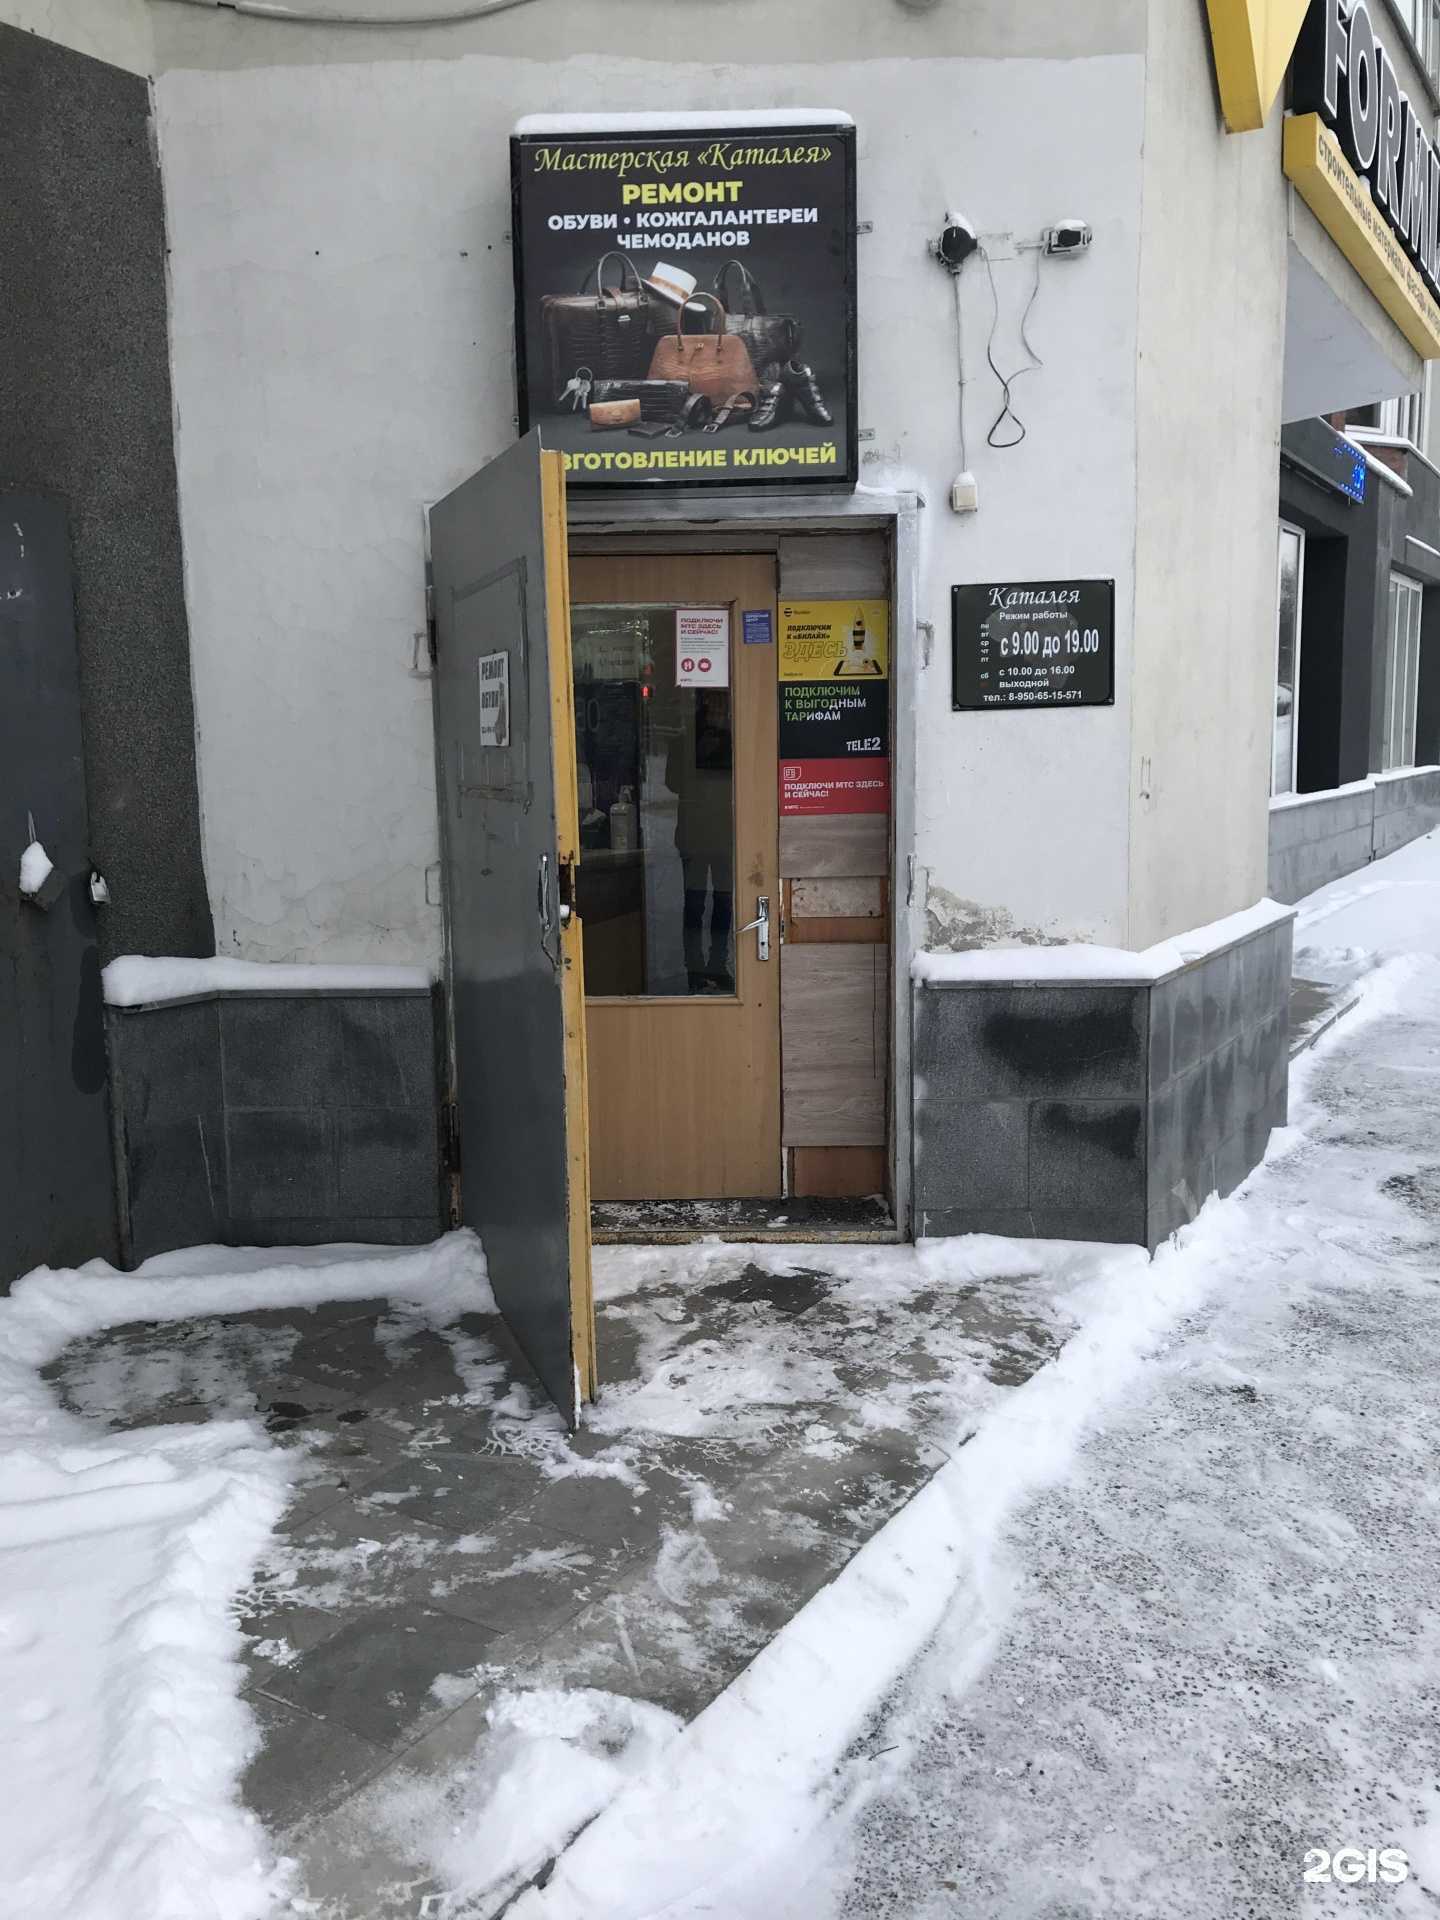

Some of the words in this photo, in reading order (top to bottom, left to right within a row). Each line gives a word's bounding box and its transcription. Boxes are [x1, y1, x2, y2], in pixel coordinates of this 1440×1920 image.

[534, 147, 689, 177] Мастерская
[697, 143, 832, 170] «Каталея»
[622, 181, 743, 205] РЕМОНТ
[547, 213, 618, 231] ОБУВИ
[636, 208, 818, 228] КОЖГАЛАНТЕРЕИ
[617, 231, 750, 250] ЧЕМОДАНОВ
[562, 449, 728, 471] ЗГОТОВЛЕНИЕ
[733, 442, 837, 466] КЛЮЧЕЙ
[989, 587, 1081, 609] Каталея
[1000, 611, 1030, 620] Режим
[1033, 611, 1068, 621] работы
[1000, 637, 1009, 656] с
[1012, 630, 1040, 655] 9.00
[1042, 635, 1061, 658] до
[1064, 629, 1099, 653] 19.00
[1008, 667, 1032, 676] 10.00
[1034, 668, 1047, 677] до
[1051, 665, 1075, 674] 16.00
[1000, 679, 1049, 688] выходной
[785, 686, 860, 698] ПОДКЛЮЧИМ
[1008, 691, 1082, 701] 8-950-65-15-571
[785, 700, 792, 709] К
[796, 698, 867, 710] ВЫГОДНЫМ
[785, 711, 841, 721] ТАРИФАМ
[846, 737, 881, 751] TELE2
[784, 782, 834, 791] ПОДКЛЮЧИ
[836, 781, 854, 789] МТС
[856, 780, 884, 788] ЗДЕСЬ
[792, 789, 829, 798] СЕЙЧАС!
